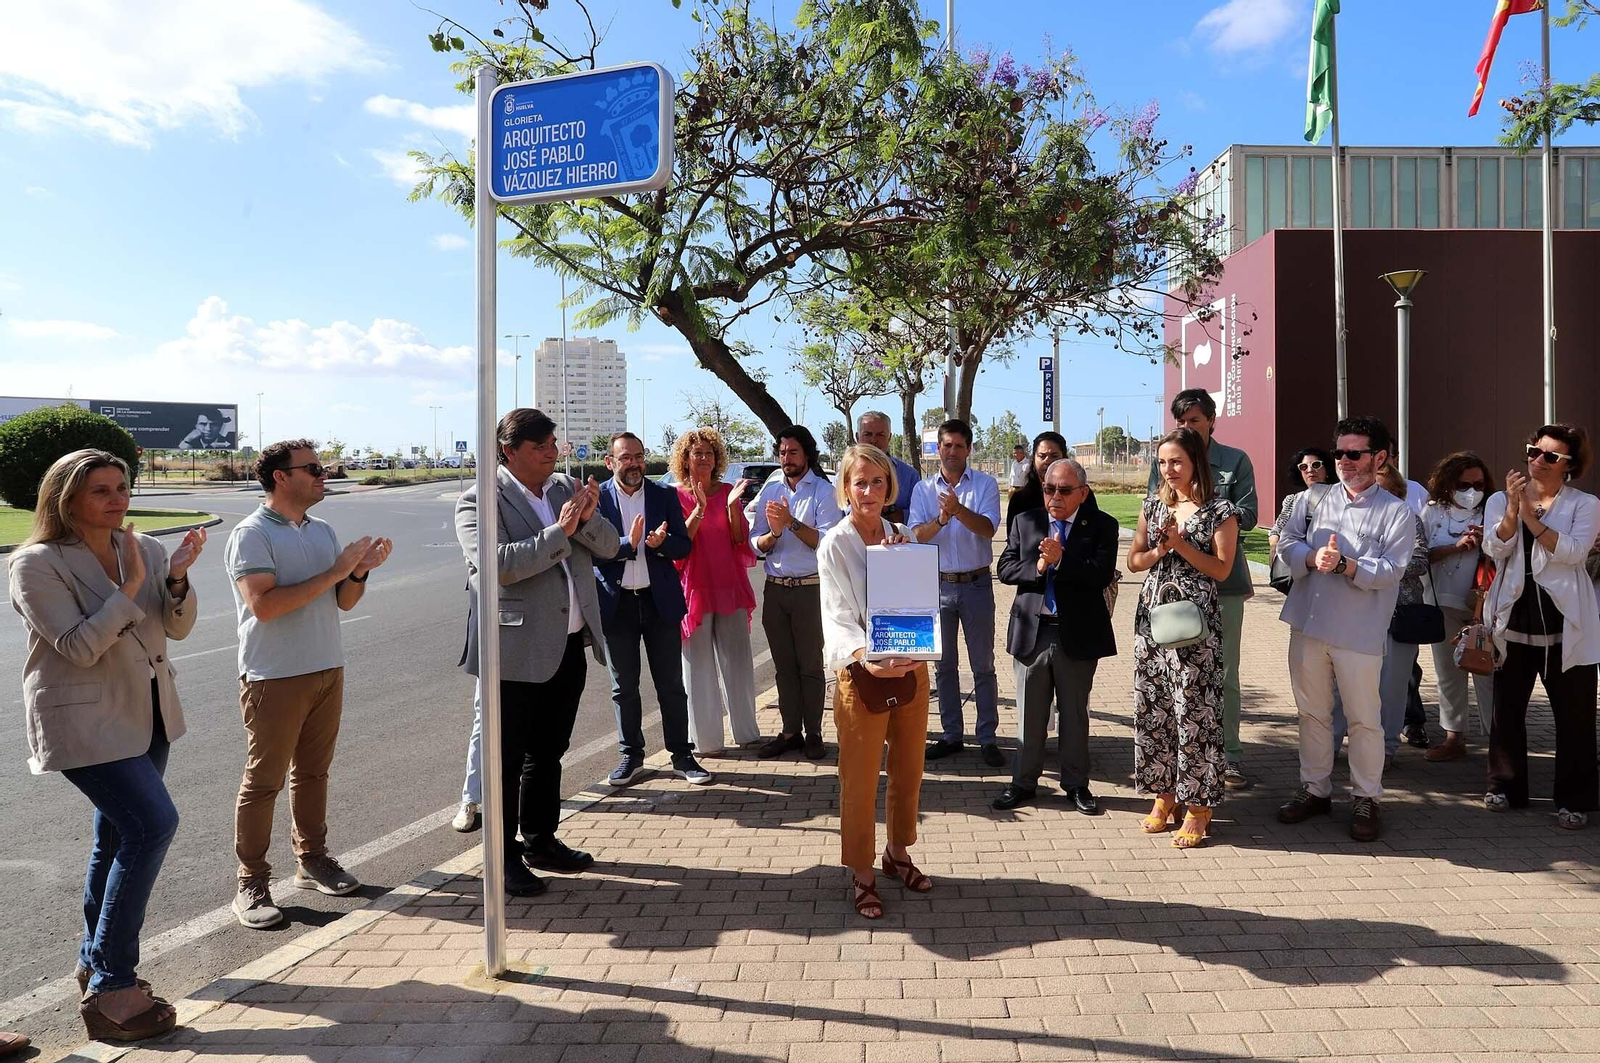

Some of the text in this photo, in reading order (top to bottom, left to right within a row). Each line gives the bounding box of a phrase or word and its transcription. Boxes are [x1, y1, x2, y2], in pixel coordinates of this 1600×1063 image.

[504, 114, 543, 126] GLORIETA
[503, 120, 586, 150] ARQUITECTO
[503, 142, 585, 171] JOSÉ PABLO
[503, 160, 618, 192] VÁZQUEZ HIERRO
[1042, 359, 1051, 369] P
[1231, 384, 1236, 399] LA
[1231, 402, 1236, 416] DE
